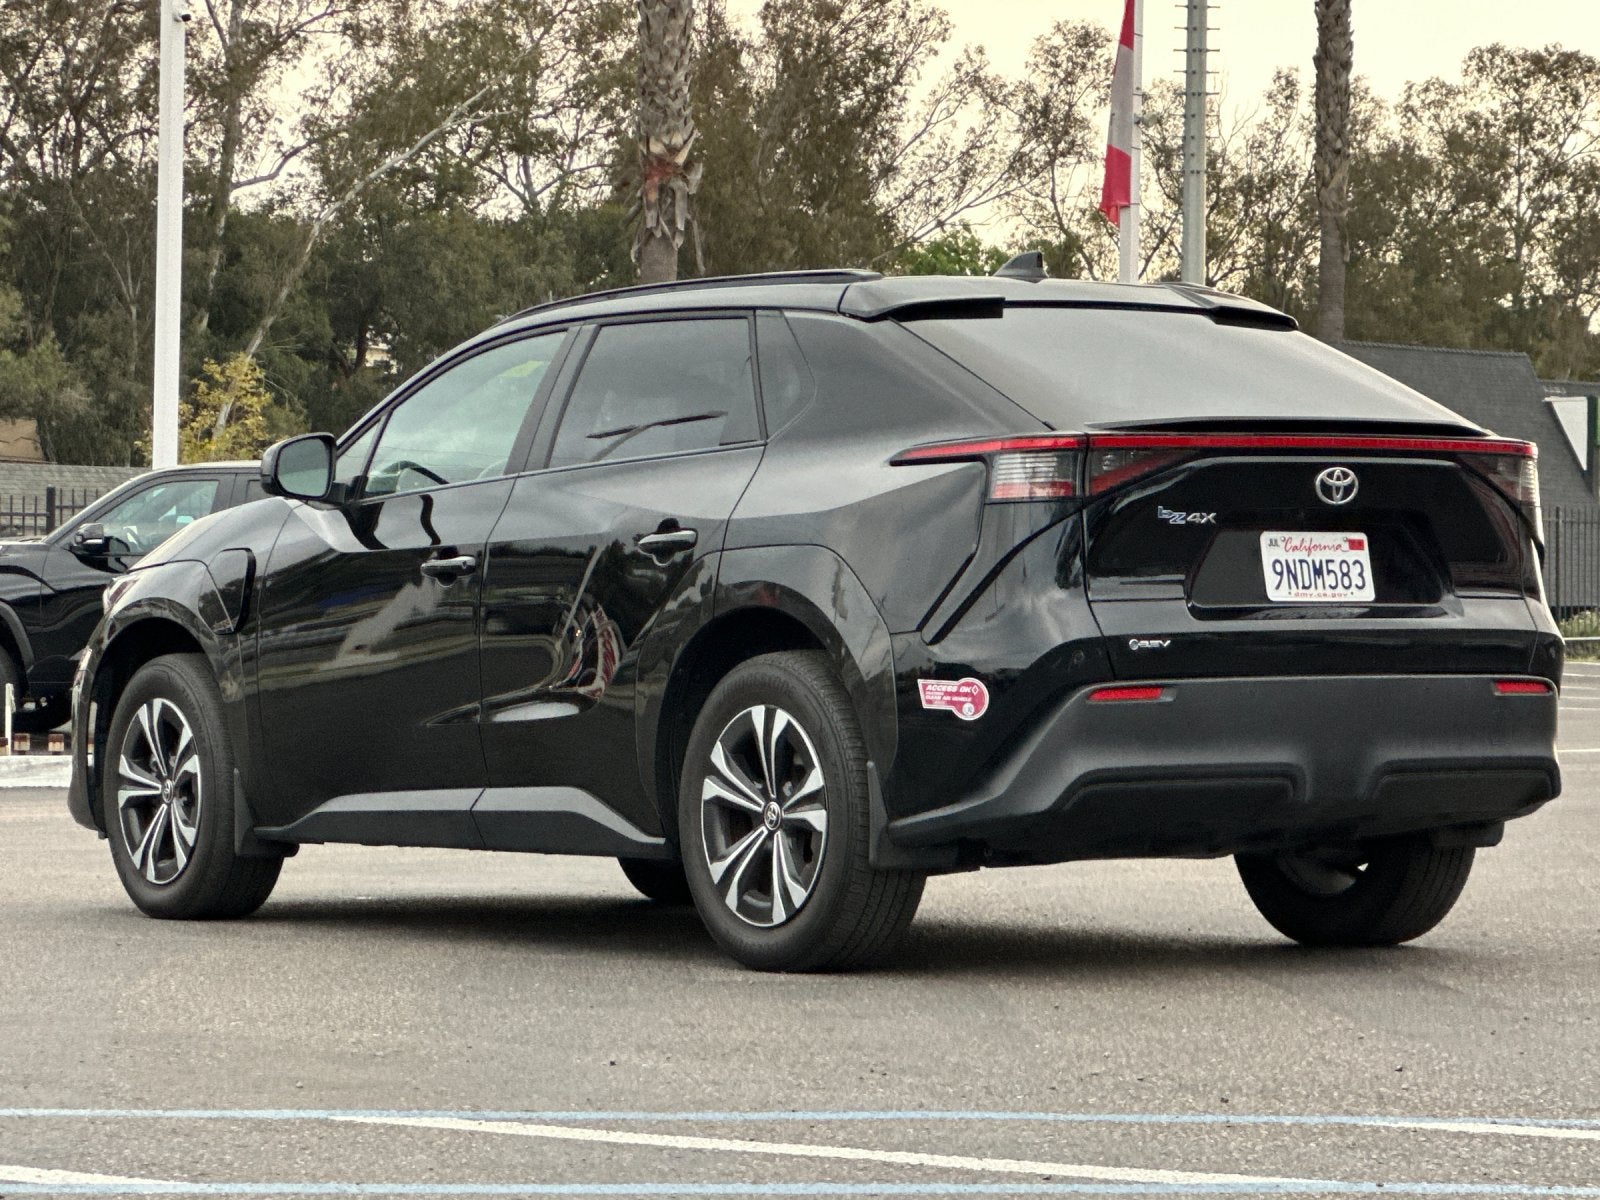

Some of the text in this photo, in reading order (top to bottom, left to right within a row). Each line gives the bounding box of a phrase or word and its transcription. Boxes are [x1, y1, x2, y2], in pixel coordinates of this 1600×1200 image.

[1284, 537, 1346, 557] California
[1271, 558, 1366, 590] 9NDM583
[926, 684, 958, 692] ACCESS
